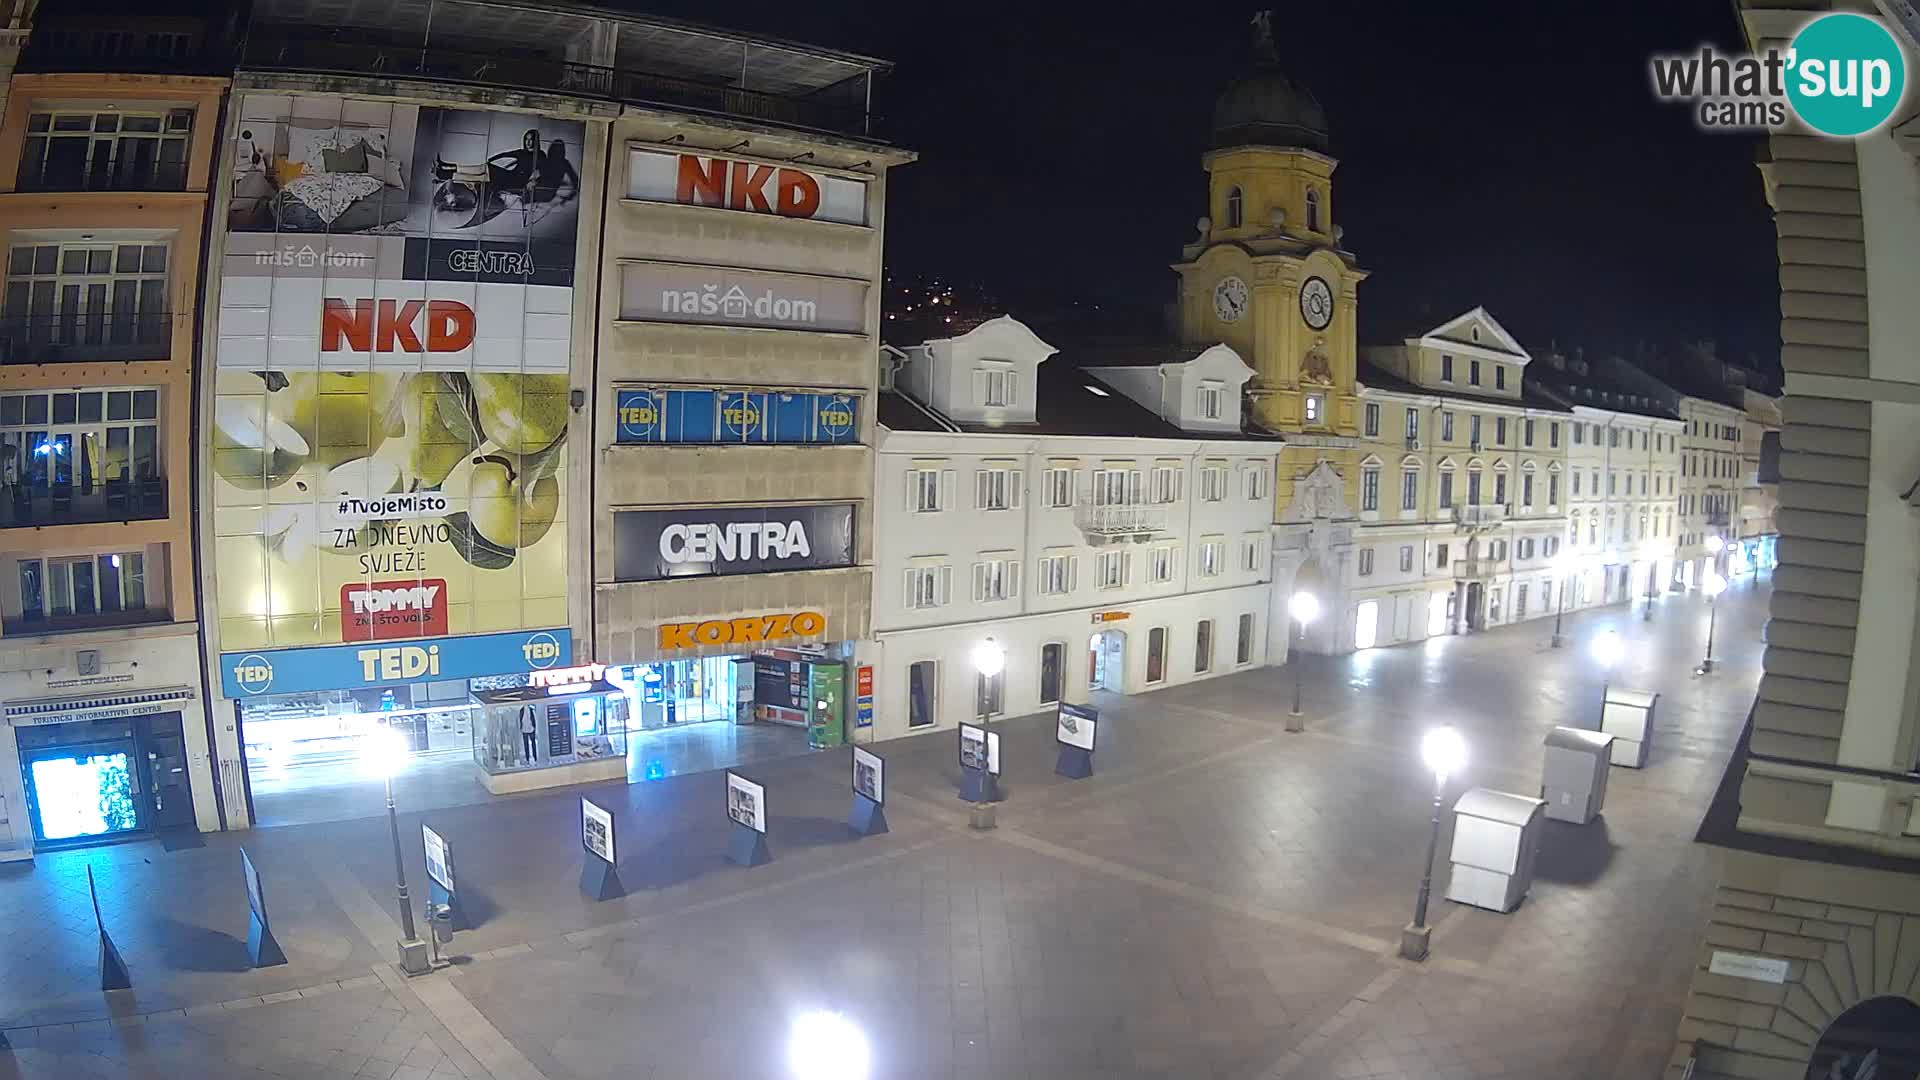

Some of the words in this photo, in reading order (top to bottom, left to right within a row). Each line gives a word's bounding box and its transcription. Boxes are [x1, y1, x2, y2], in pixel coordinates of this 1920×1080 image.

[676, 153, 820, 219] NKD
[255, 245, 294, 268] naš
[320, 246, 366, 269] dom
[448, 249, 535, 275] CENTRA
[662, 284, 718, 315] naš
[754, 289, 816, 322] dom
[320, 297, 477, 353] NKD
[619, 407, 658, 425] TEDi
[723, 408, 760, 426] TEDi
[820, 410, 854, 426] TEDi
[338, 496, 446, 516] #TvojeMisto
[333, 528, 358, 549] ZA
[367, 523, 451, 547] DNEVNO
[659, 520, 811, 564] CENTRA
[359, 547, 427, 575] SVJEŽE
[348, 586, 439, 614] TOMMY
[380, 613, 400, 626] ŠTO
[659, 611, 826, 650] KORZO
[357, 644, 440, 682] TEDi
[521, 640, 561, 661] TEDi
[233, 664, 273, 683] TEDi
